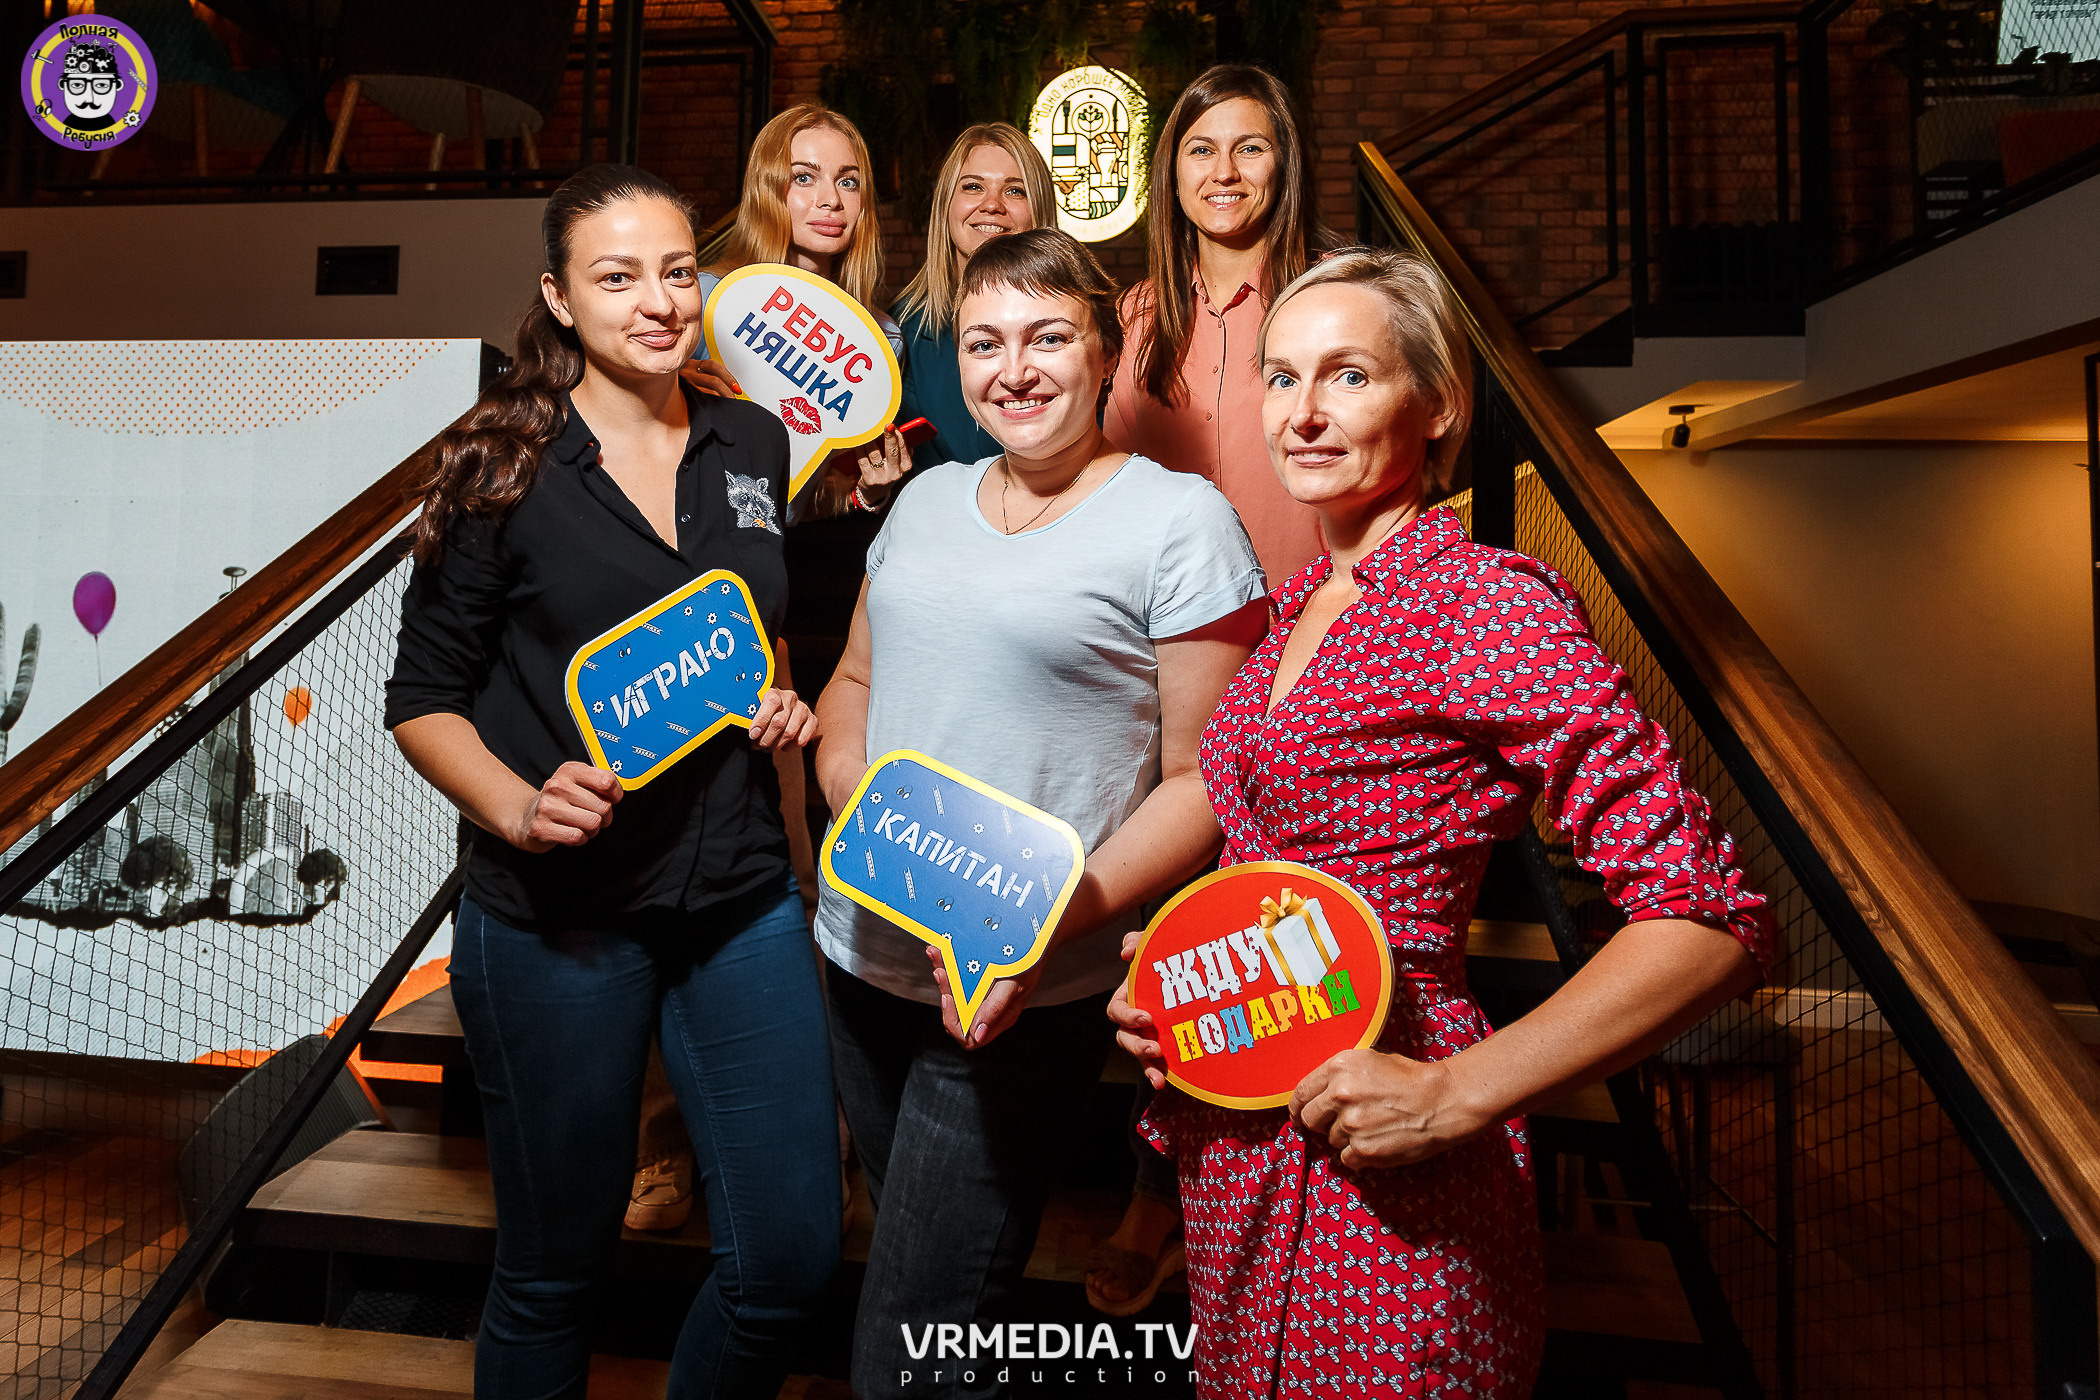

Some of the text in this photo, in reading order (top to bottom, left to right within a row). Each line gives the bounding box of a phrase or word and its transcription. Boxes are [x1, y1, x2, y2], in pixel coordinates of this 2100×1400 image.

[732, 311, 854, 422] НЯШКА
[761, 285, 873, 384] РЕБУС
[609, 627, 736, 729] ИГРАЮ
[873, 807, 1035, 909] КАПИТАН
[1152, 925, 1272, 1010] ЖДУ
[1171, 969, 1361, 1063] ПОДАРКИ
